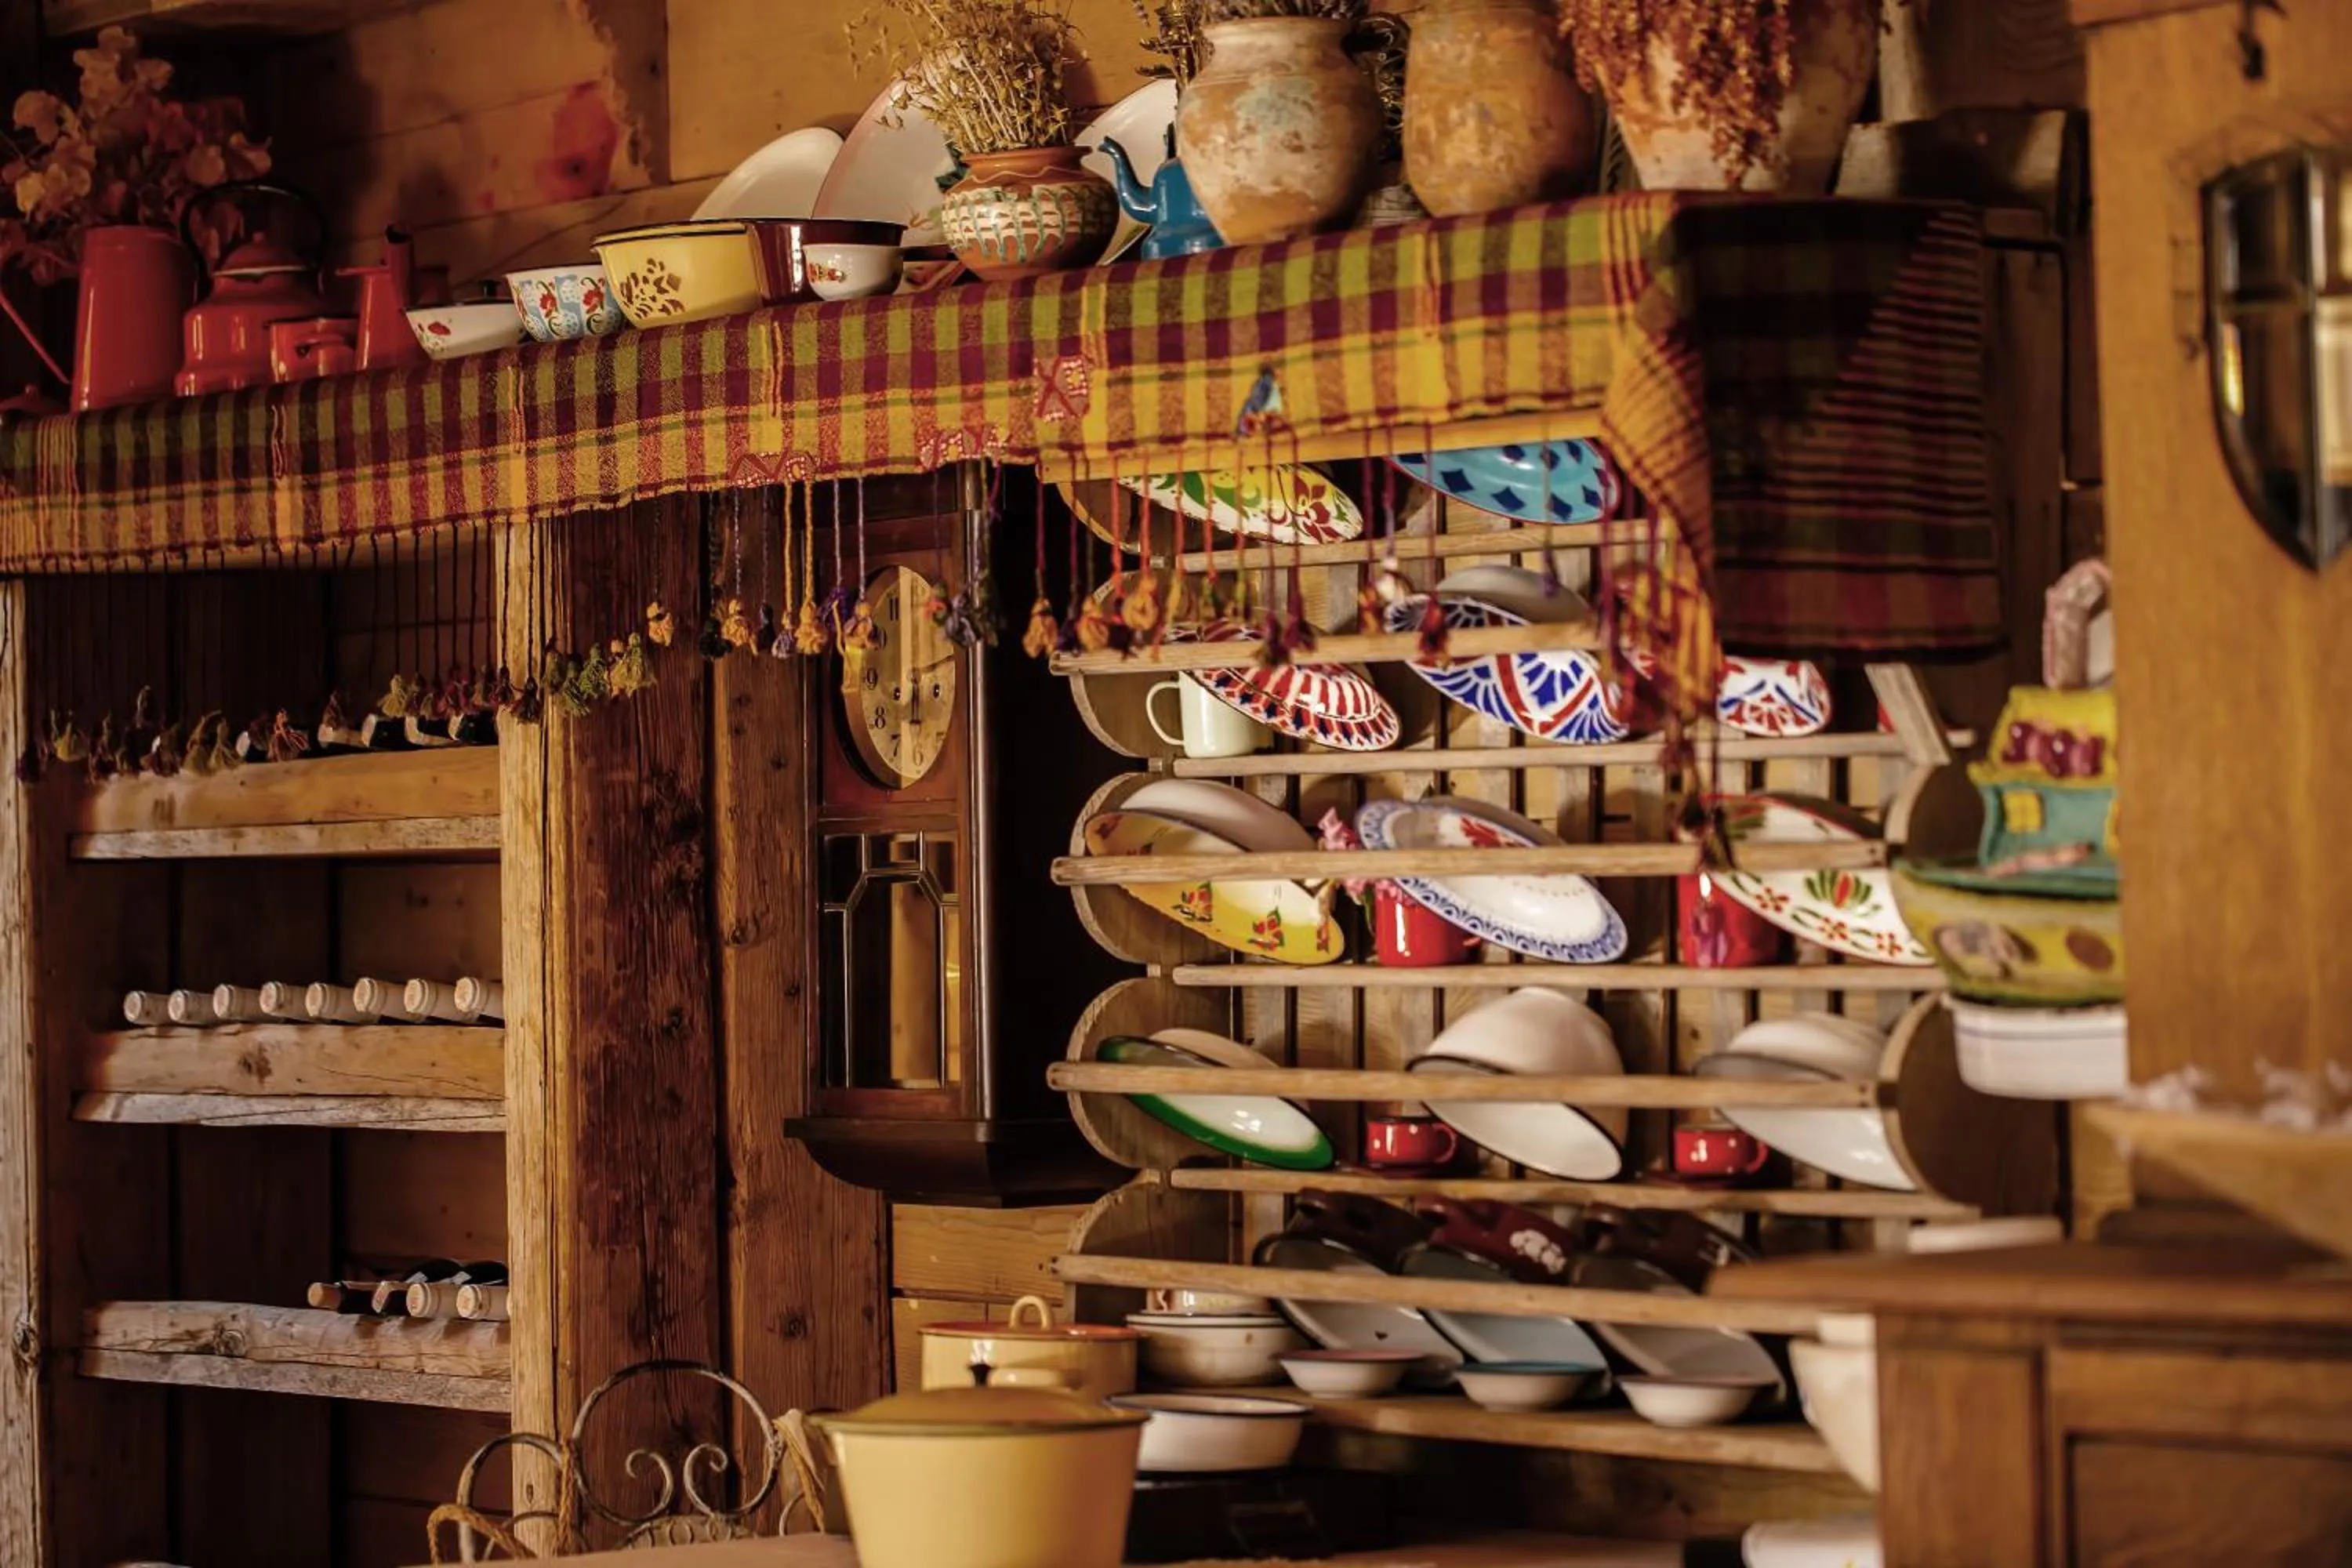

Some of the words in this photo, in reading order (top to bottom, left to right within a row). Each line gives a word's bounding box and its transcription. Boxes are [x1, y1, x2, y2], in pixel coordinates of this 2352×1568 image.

[866, 667, 879, 691] 9
[874, 706, 886, 730] 8
[890, 733, 902, 757] 7
[912, 741, 924, 767] 6
